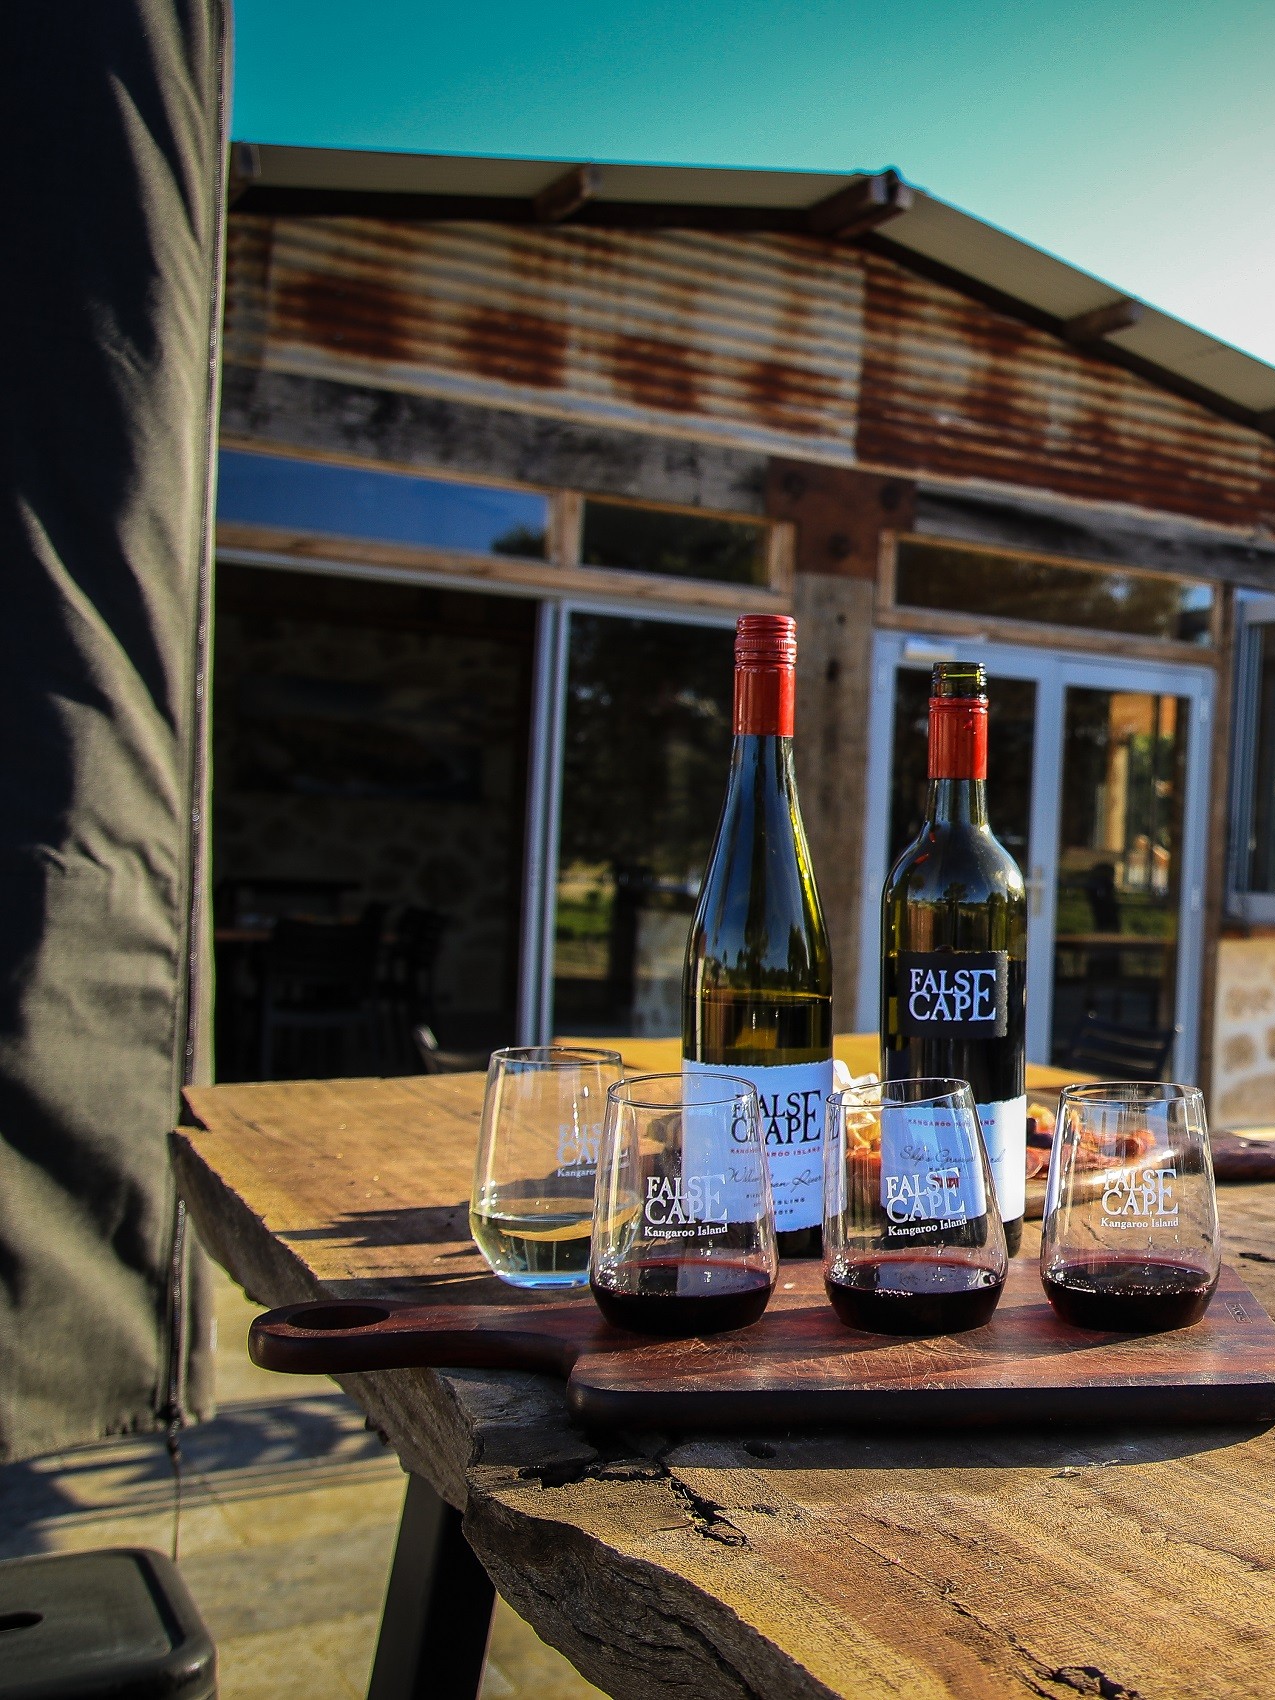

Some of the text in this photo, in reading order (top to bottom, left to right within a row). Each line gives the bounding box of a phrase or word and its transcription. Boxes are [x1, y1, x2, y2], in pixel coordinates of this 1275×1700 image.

[910, 969, 996, 1001] FALSE
[909, 989, 996, 1021] CAPE
[731, 1111, 821, 1145] CAPE
[646, 1174, 727, 1205] FALSE
[886, 1167, 963, 1200] FALSE
[1104, 1168, 1178, 1198] FALSE
[645, 1192, 728, 1225] CAPE
[886, 1188, 966, 1223] CAPE
[1101, 1187, 1179, 1216] CAPE
[644, 1223, 728, 1239] Kangaroo Island
[887, 1214, 968, 1237] Kangaroo Island
[1101, 1216, 1179, 1230] Kangaroo Island
